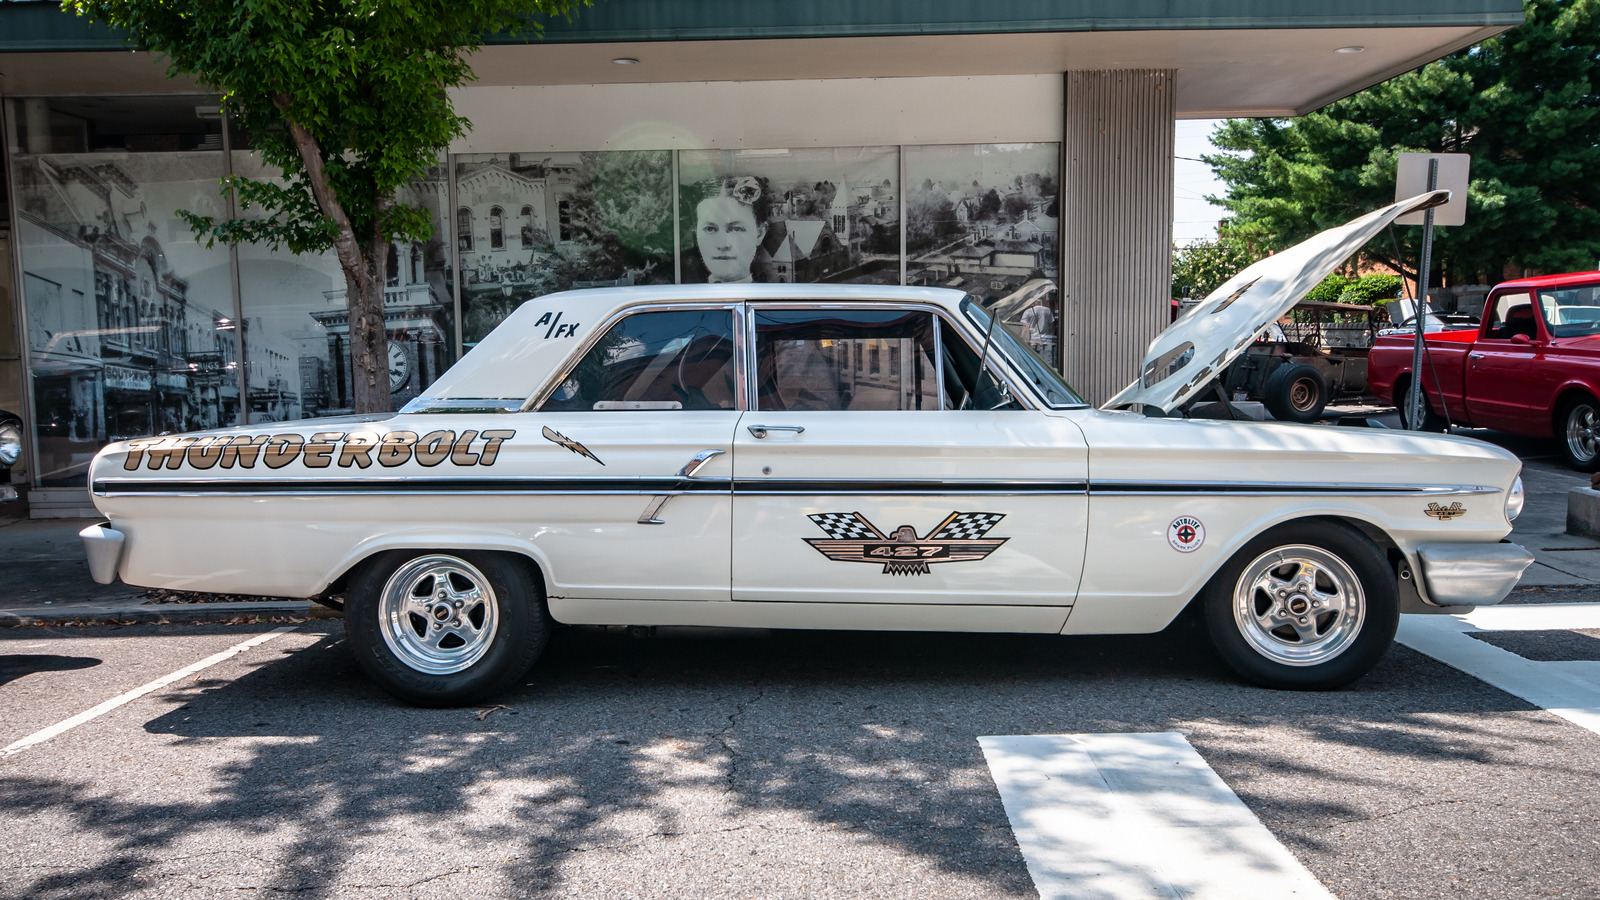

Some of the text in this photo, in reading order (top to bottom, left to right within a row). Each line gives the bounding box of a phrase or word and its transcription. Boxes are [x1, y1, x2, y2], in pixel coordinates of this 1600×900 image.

[534, 311, 580, 339] A/FX
[1171, 348, 1228, 402] 427
[123, 429, 517, 471] THUNDERBOLT
[1172, 518, 1200, 530] AUTOLITE
[870, 546, 943, 557] 427
[1172, 539, 1201, 550] SPARK PLUGS
